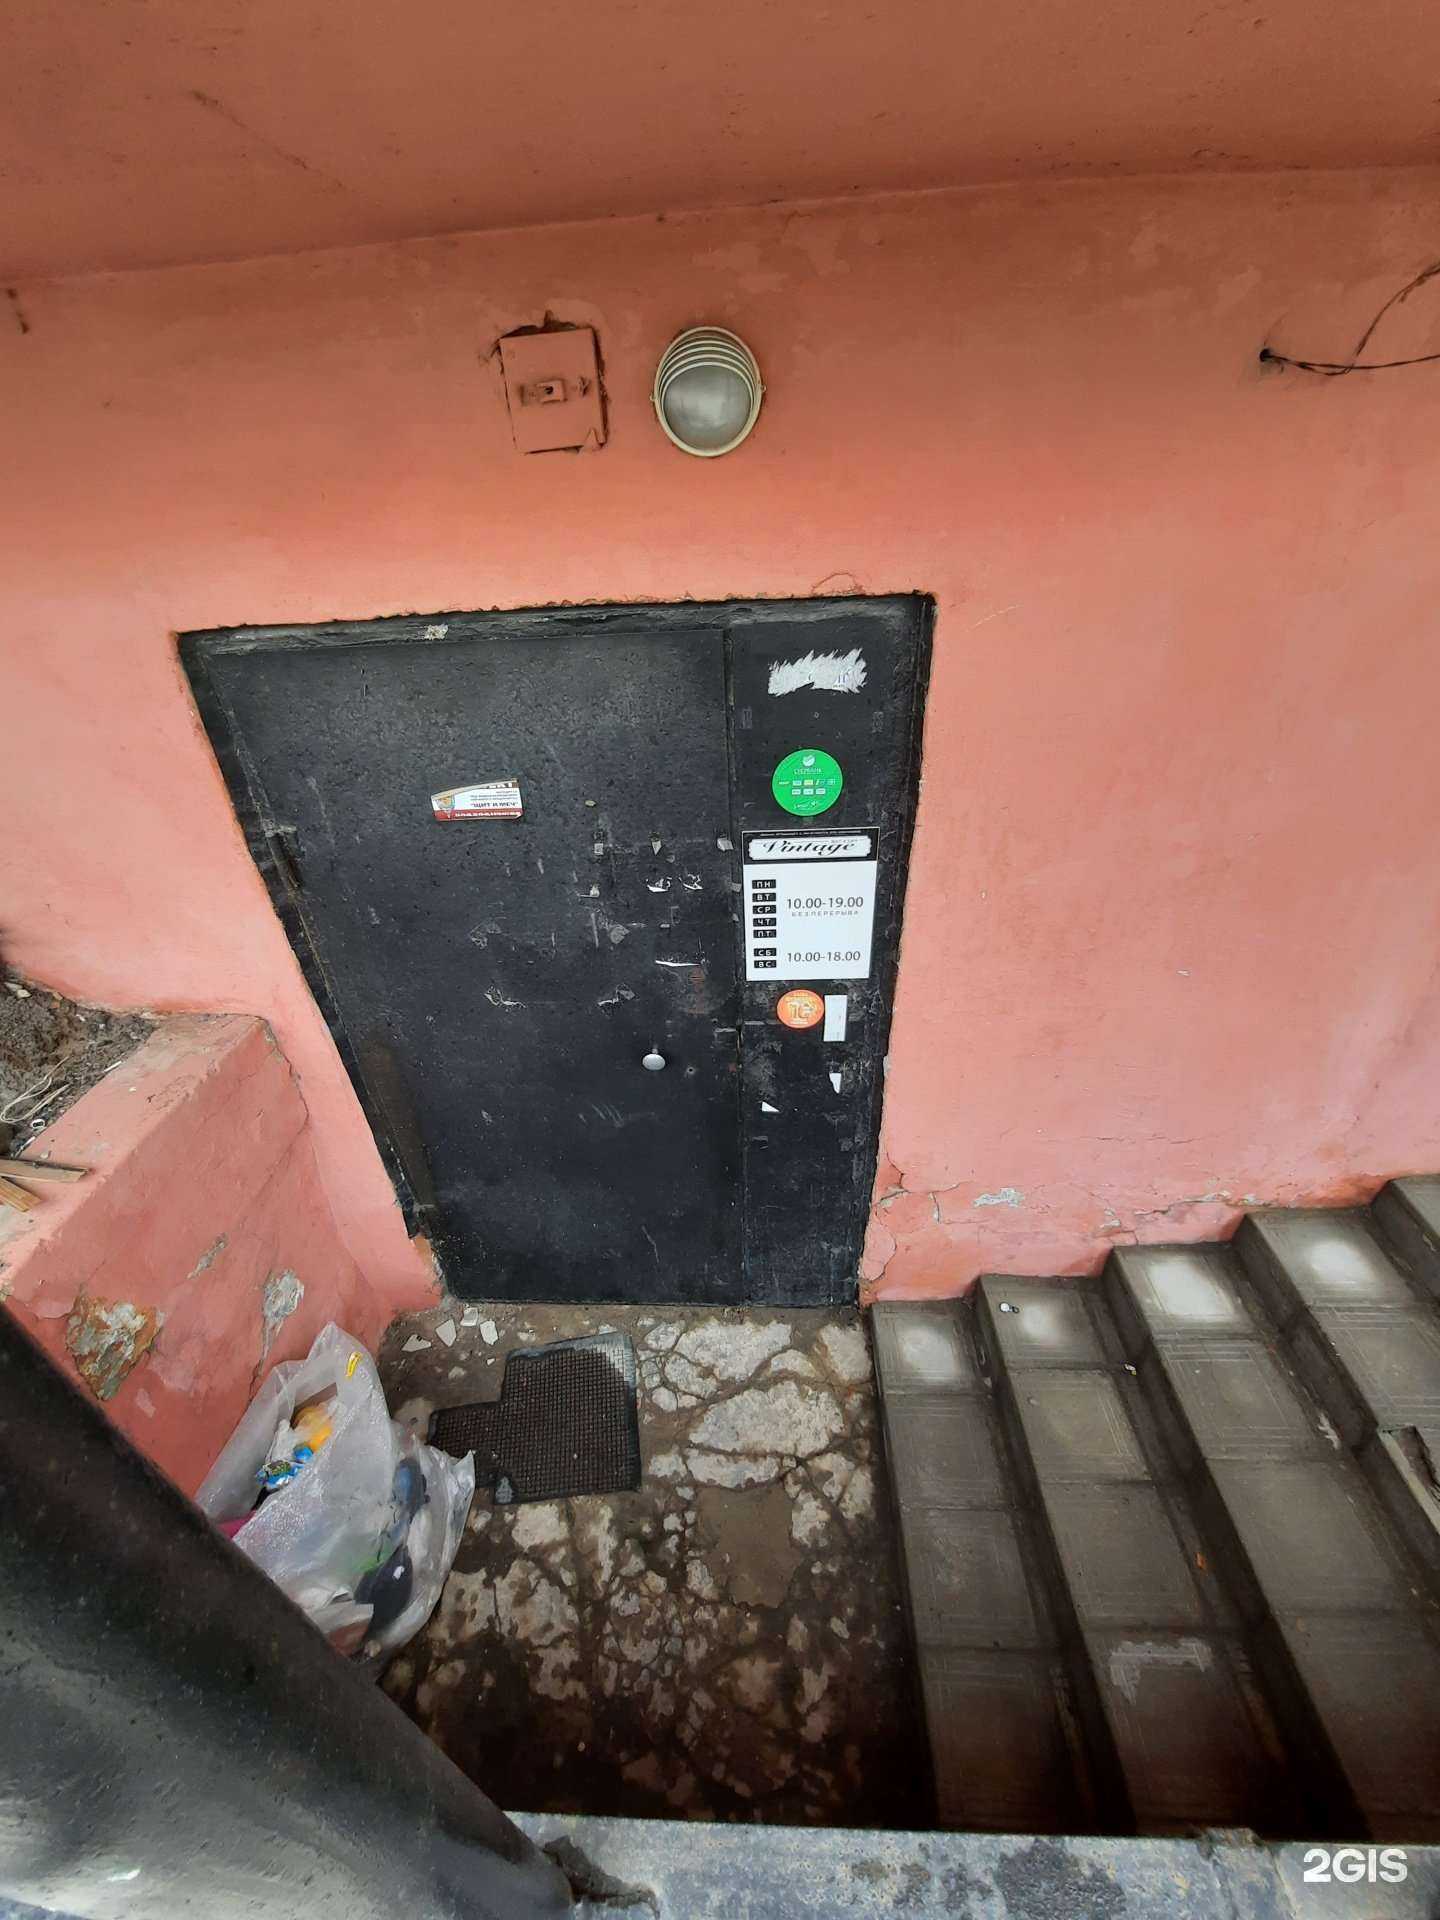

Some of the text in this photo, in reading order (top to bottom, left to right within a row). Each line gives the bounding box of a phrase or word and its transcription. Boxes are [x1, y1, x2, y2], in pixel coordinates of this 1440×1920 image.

[762, 840, 855, 856] Vintage
[786, 896, 864, 909] 10.00-19.00
[787, 951, 861, 962] 10.00-18.00
